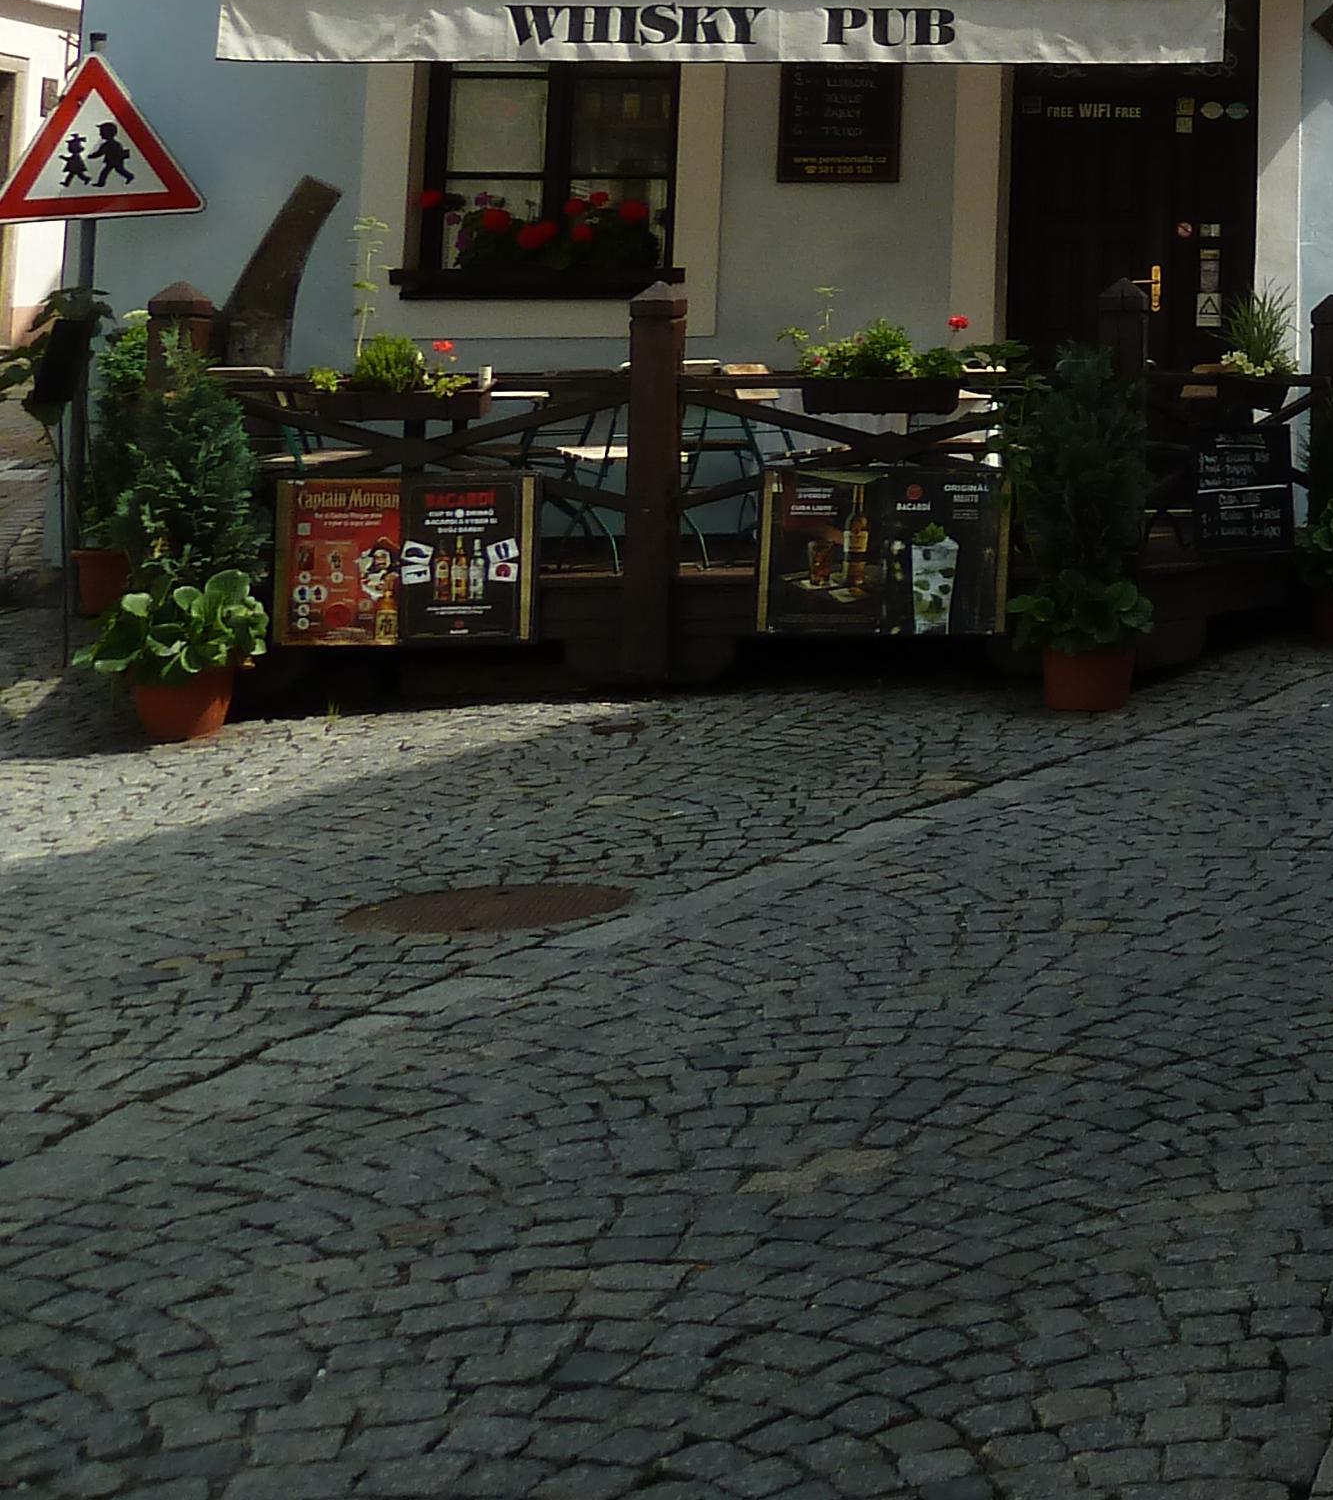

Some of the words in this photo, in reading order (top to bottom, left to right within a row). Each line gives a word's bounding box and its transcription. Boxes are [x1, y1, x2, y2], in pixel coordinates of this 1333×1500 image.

[503, 2, 767, 47] WHISKY
[822, 7, 956, 47] PUB
[1047, 106, 1074, 118] FREE
[1114, 106, 1142, 119] FREE
[297, 490, 346, 510] Captain
[347, 488, 400, 511] Morgan
